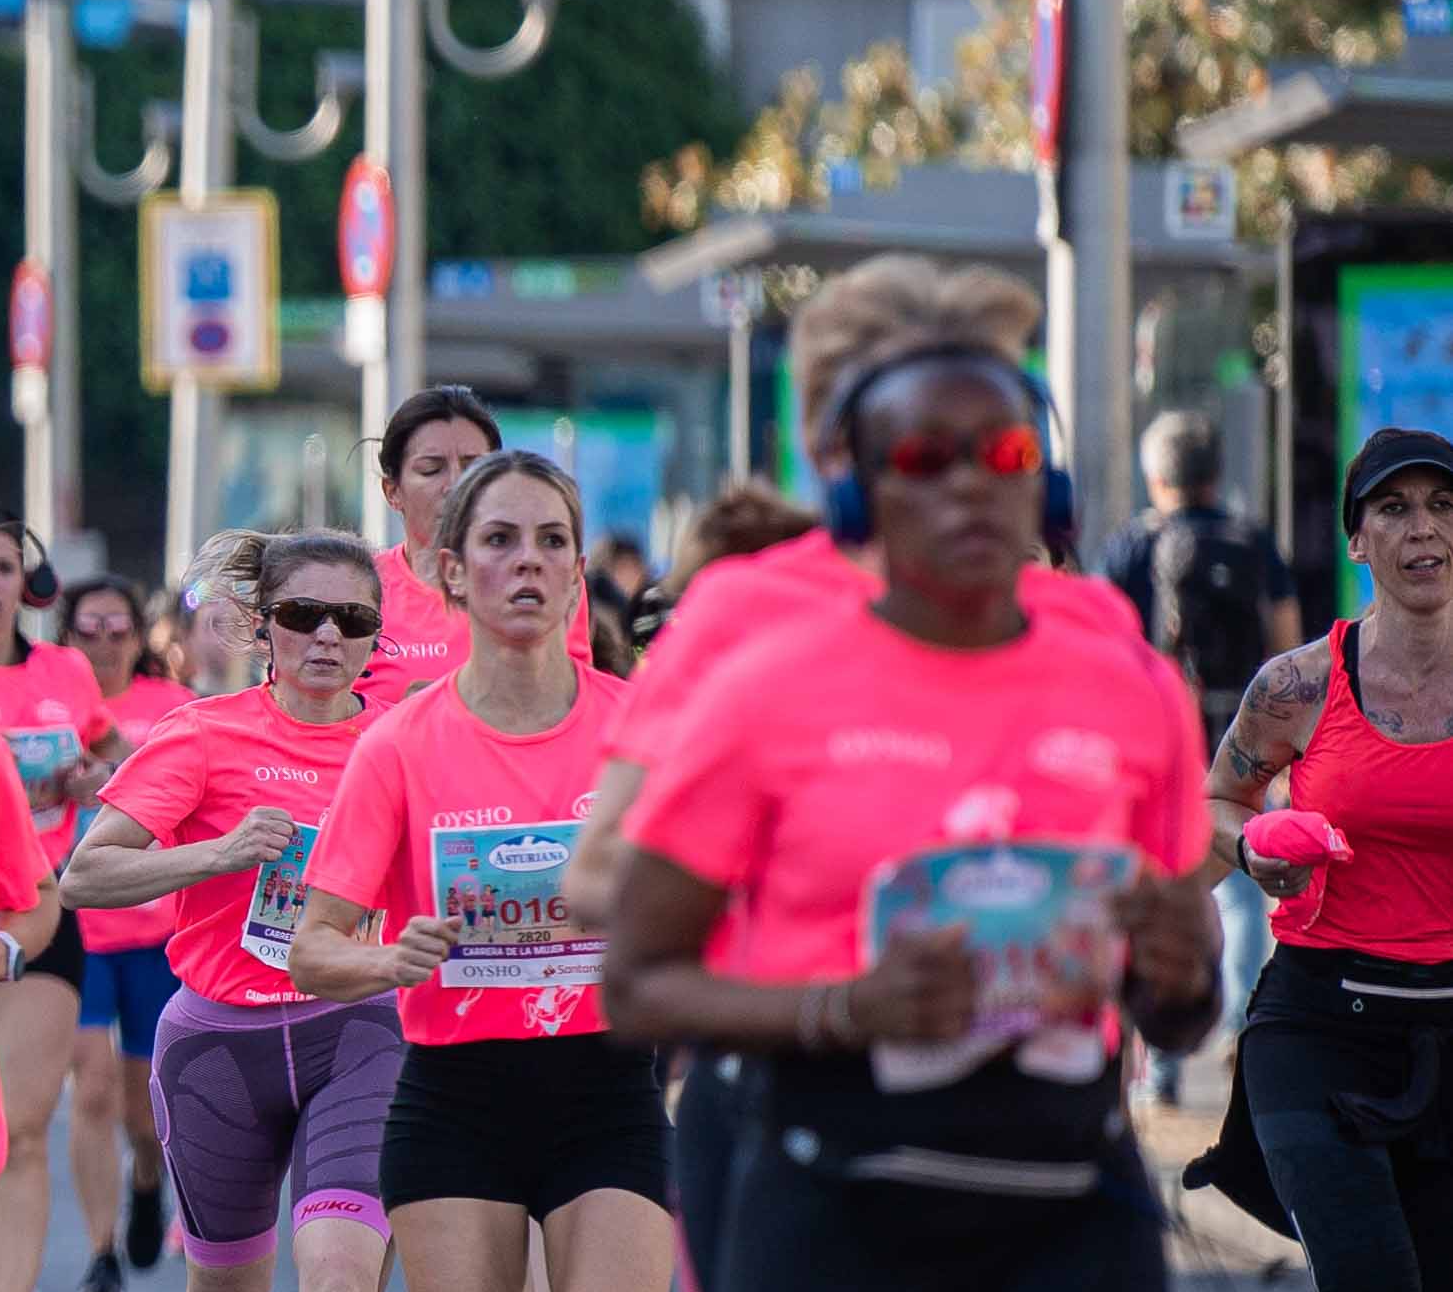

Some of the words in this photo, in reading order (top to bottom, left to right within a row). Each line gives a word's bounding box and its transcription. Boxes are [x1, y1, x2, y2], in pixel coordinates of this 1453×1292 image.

[385, 642, 448, 660] OYSHO
[255, 766, 319, 785] OYSHO
[434, 806, 512, 827] OYSHO
[495, 850, 565, 866] ASTURIANA
[499, 896, 571, 925] 016
[517, 931, 551, 943] 2820
[259, 944, 287, 960] OYS
[462, 947, 504, 957] CARRERA
[506, 947, 519, 956] DE
[522, 946, 533, 955] LA
[535, 944, 564, 955] MUJER
[463, 965, 522, 979] OYSHO
[283, 992, 294, 1002] DE
